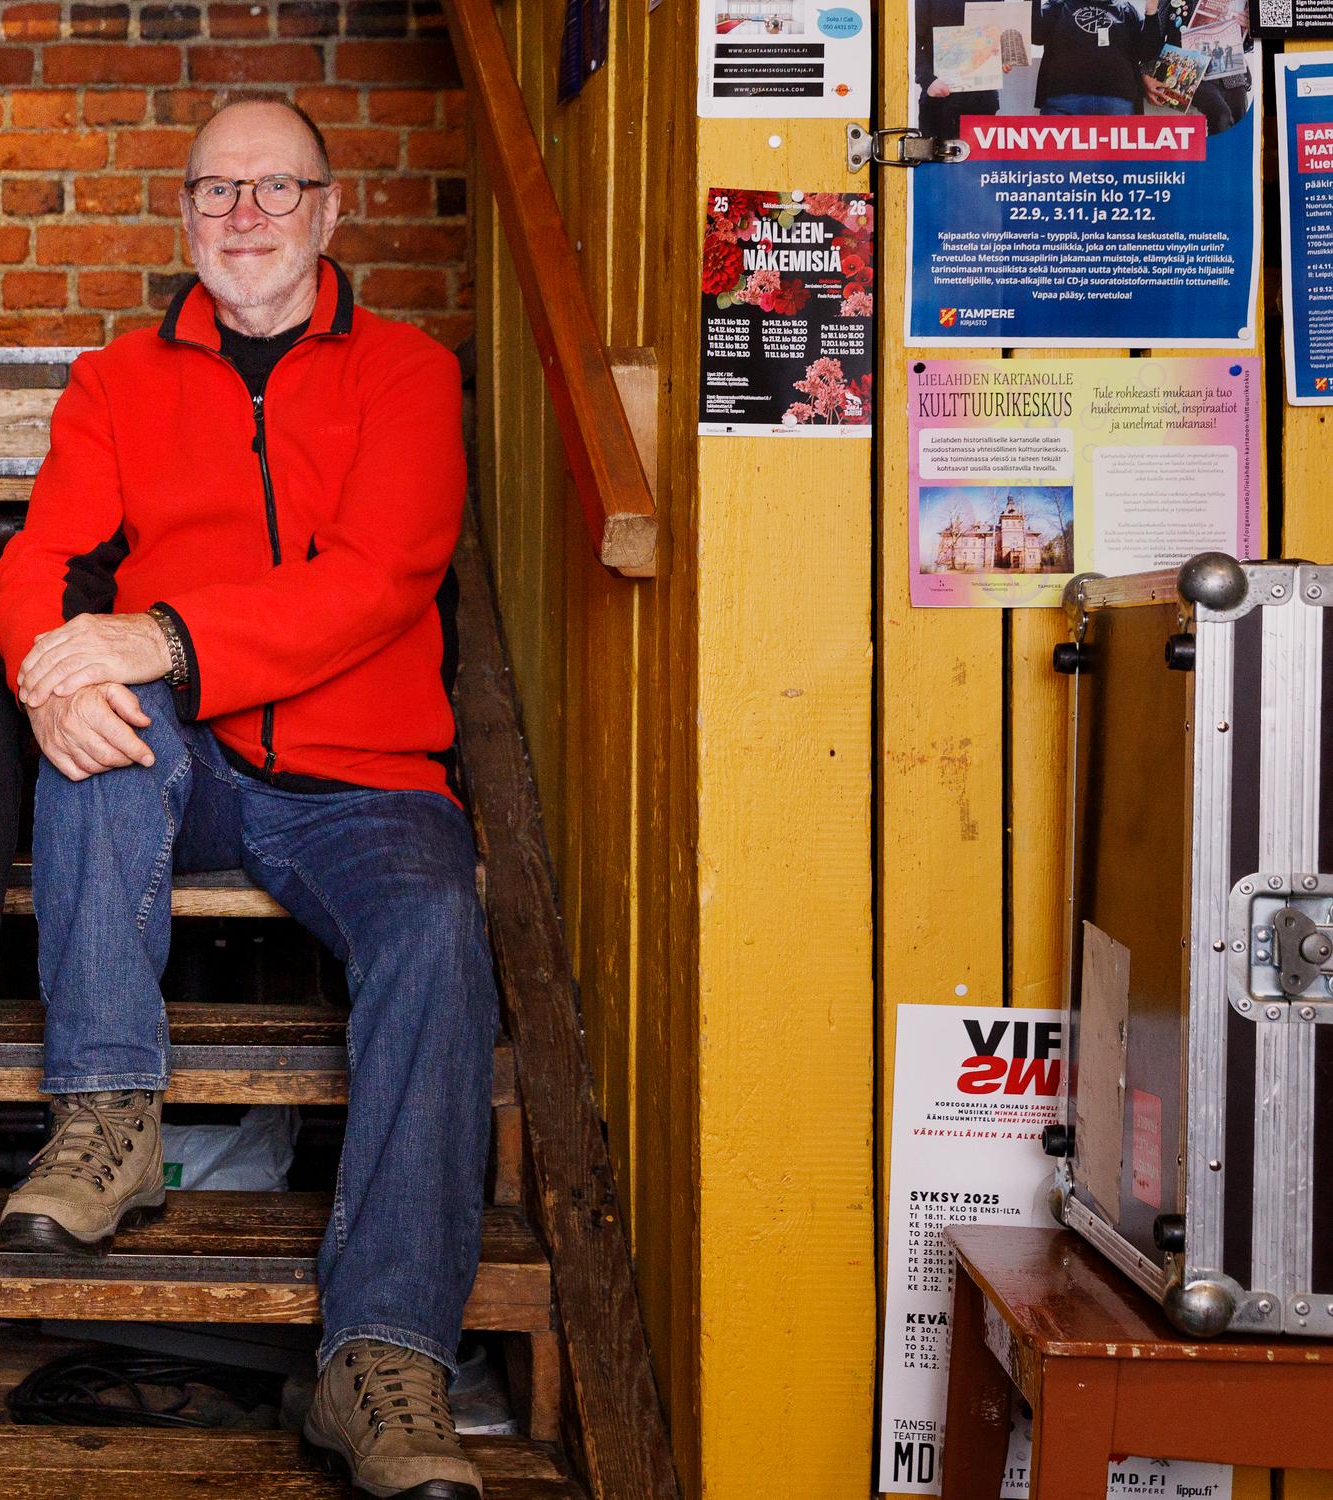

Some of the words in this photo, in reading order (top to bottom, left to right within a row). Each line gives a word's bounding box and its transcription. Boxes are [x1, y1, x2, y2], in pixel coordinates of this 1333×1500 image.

[973, 127, 1195, 149] VINYYLI-ILLAT
[980, 171, 1064, 187] pääkirjasto
[1069, 172, 1118, 186] Metso,
[1123, 172, 1185, 185] musiikki
[996, 189, 1096, 202] maanantaisin
[1102, 190, 1123, 202] klo
[714, 197, 728, 212] 25
[849, 200, 866, 215] 26
[1010, 208, 1049, 221] 22.9.,
[1054, 208, 1088, 221] 3.11.
[1092, 208, 1107, 223] ja
[1111, 208, 1155, 221] 22.12.
[751, 217, 833, 243] JÄLLEEN-
[938, 232, 980, 240] Kaipaatko
[982, 232, 1039, 243] vinyylikaveria
[1047, 232, 1080, 243] tyyppiä,
[1081, 232, 1104, 243] jonka
[1107, 232, 1135, 240] kanssa
[1137, 232, 1186, 241] keskustella,
[1189, 232, 1229, 241] muistella,
[943, 243, 978, 251] ihastella
[980, 243, 992, 251] tai
[993, 243, 1011, 252] jopa
[1014, 243, 1040, 251] inhota
[1043, 243, 1084, 252] musiikkia,
[1085, 243, 1104, 252] joka
[1166, 244, 1199, 253] vinyylin
[743, 245, 842, 272] NÄKEMISIÄ
[932, 254, 976, 262] Tervetuloa
[1012, 255, 1058, 264] musapiiriin
[1060, 255, 1101, 264] jakamaan
[1103, 255, 1141, 264] muistoja,
[1143, 255, 1184, 264] elämyksiä
[1186, 255, 1194, 264] ja
[1196, 255, 1234, 264] kritiikkiä,
[1050, 266, 1087, 274] luomaan
[1113, 267, 1150, 275] yhteisöä.
[1152, 267, 1172, 275] Sopii
[1174, 267, 1196, 275] myös
[1198, 267, 1234, 275] hiljaisille
[934, 277, 993, 286] ihmettelijöille,
[996, 278, 1052, 286] vasta-alkajille
[1067, 277, 1088, 286] CD-ja
[1186, 278, 1230, 286] tottuneille.
[1032, 291, 1057, 301] Vapaa
[1060, 291, 1085, 301] pääsy,
[958, 309, 1015, 318] TAMPERE
[918, 373, 989, 386] LIELAHDEN
[994, 373, 1074, 385] KARTANOLLE
[1093, 387, 1113, 398] Tule
[1116, 386, 1160, 398] rohkeasti
[1162, 388, 1202, 398] mukaan
[1204, 389, 1213, 401] ja
[1216, 389, 1232, 398] tuo
[919, 393, 1072, 417] KULTTUURIKESKUS
[1091, 402, 1150, 414] huikeimmat
[1152, 403, 1180, 415] visiot,
[1182, 402, 1237, 416] inspiraatiot
[1109, 420, 1120, 433] ja
[1123, 419, 1163, 429] unelmat
[1166, 418, 1217, 429] mukanasi!
[926, 1114, 995, 1122] ÄÄNISUUNNITTELU
[913, 1128, 997, 1138] VÄRIKYLLÄINEN
[911, 1191, 959, 1203] SYKSY
[964, 1194, 999, 1204] 2025
[980, 1207, 1021, 1215] ENSI-ILTA
[907, 1312, 949, 1325] KEVÄ
[894, 1419, 936, 1431] TANSSI
[893, 1432, 936, 1442] TEATTERI
[893, 1442, 934, 1484] MD
